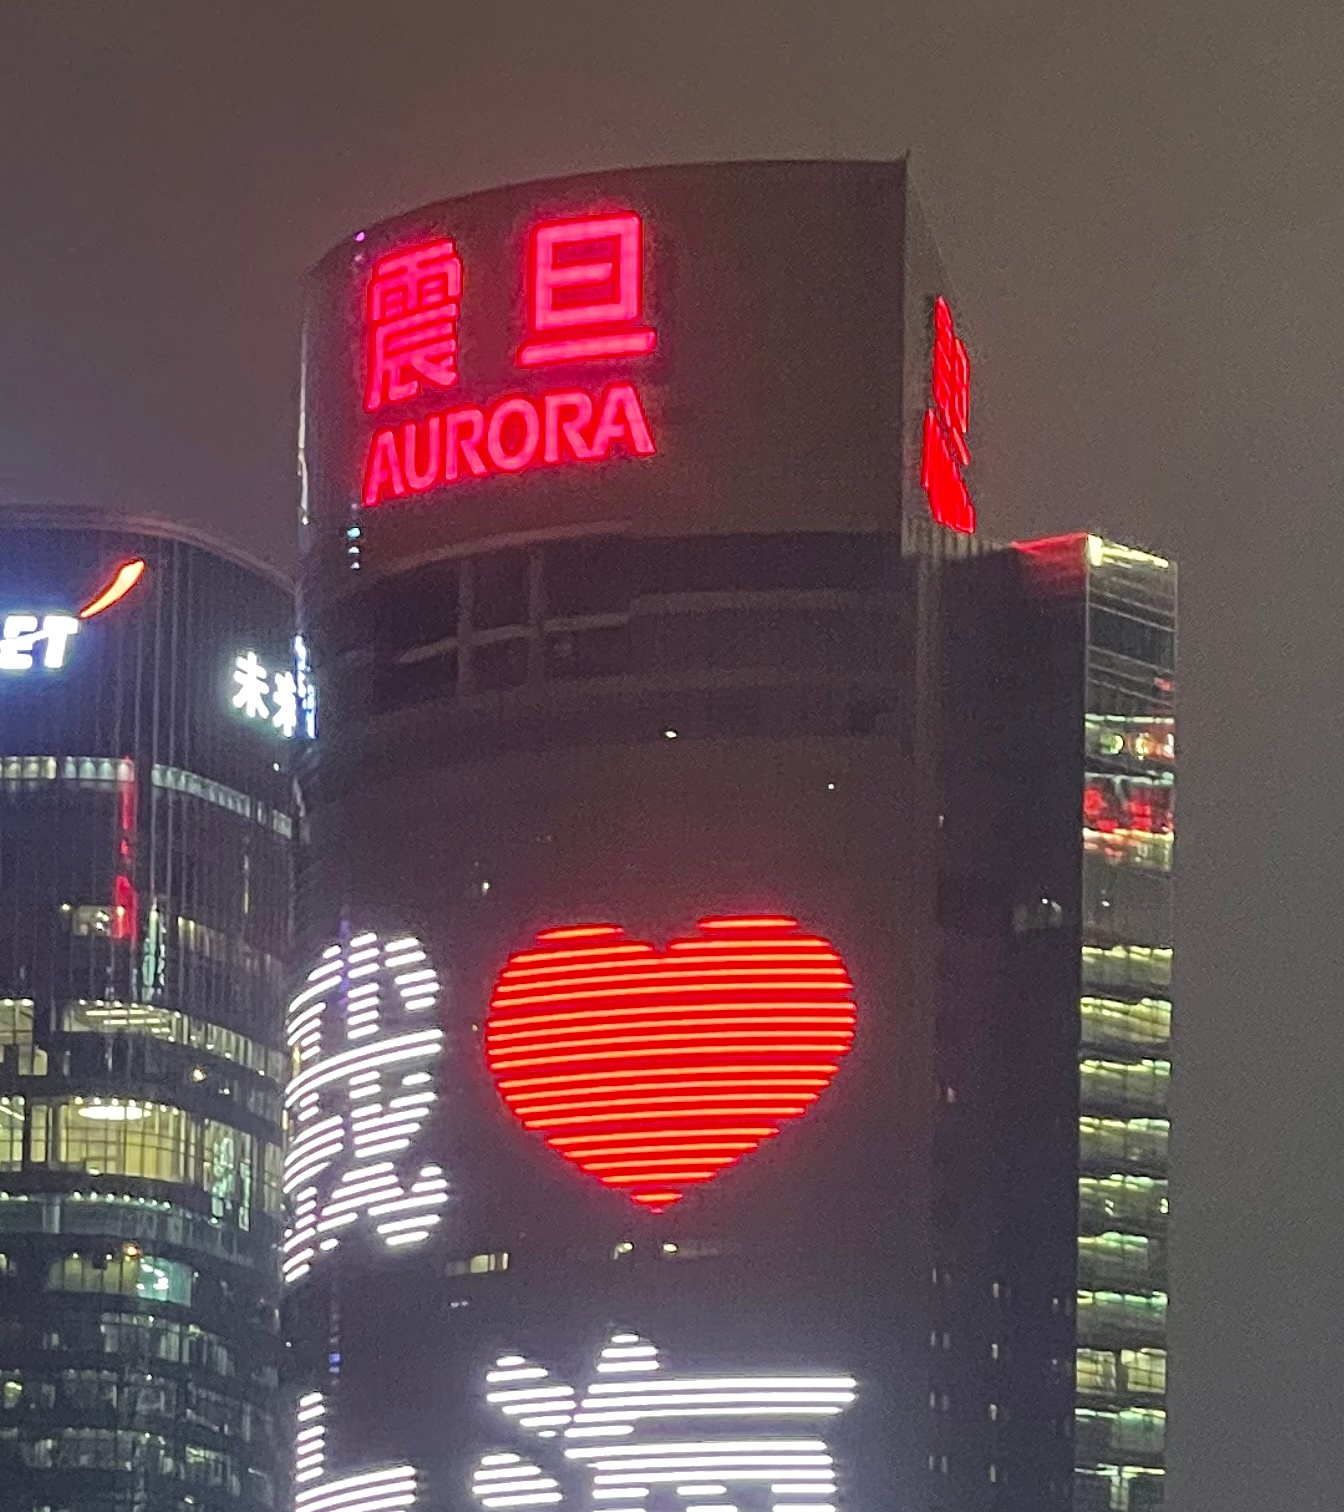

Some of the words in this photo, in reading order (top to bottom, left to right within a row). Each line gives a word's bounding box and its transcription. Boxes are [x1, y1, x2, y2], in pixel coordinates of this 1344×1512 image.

[363, 210, 656, 412] 震旦
[362, 382, 656, 507] AURORA
[283, 930, 450, 1284] 我
